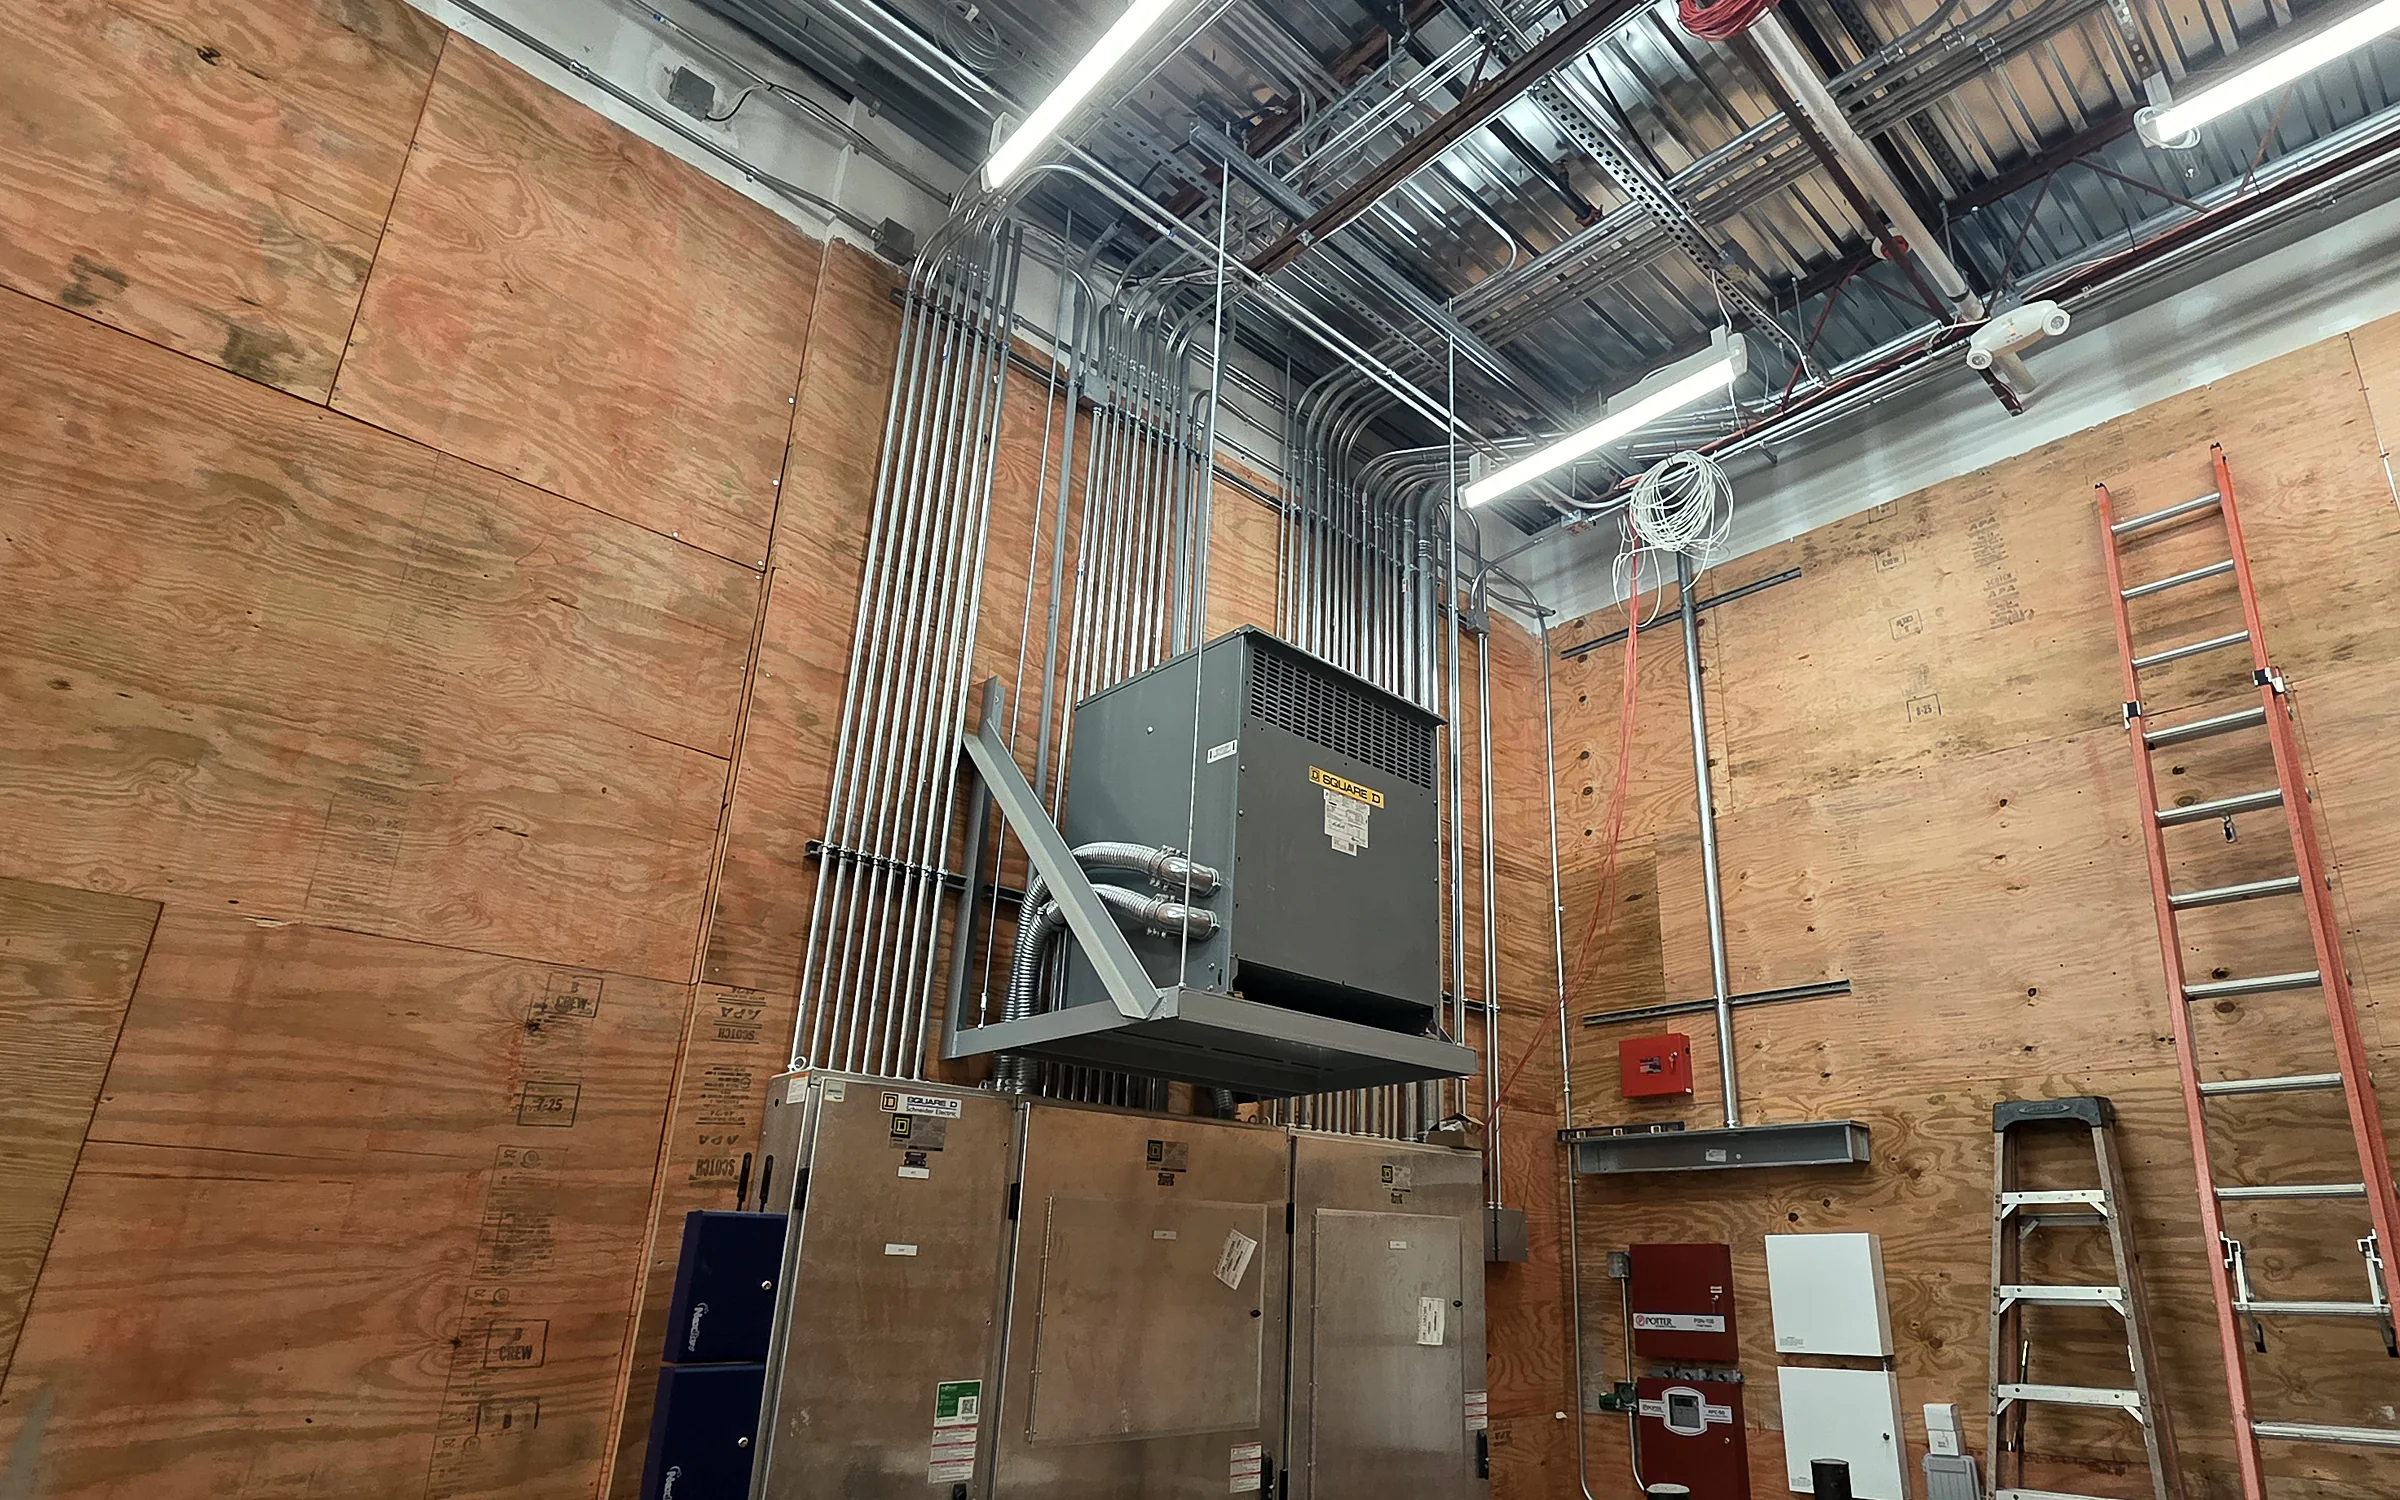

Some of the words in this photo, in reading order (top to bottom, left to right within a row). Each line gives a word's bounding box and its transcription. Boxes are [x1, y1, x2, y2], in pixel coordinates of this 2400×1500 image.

[1323, 774, 1368, 800] SQUARE
[1372, 793, 1380, 804] D
[718, 1028, 755, 1040] SCOTCH
[907, 1096, 946, 1107] SQUARE
[936, 1109, 957, 1117] Electric
[695, 1159, 735, 1177] SCOTCH
[1646, 1317, 1672, 1326] POTTER
[500, 1345, 532, 1361] CREW
